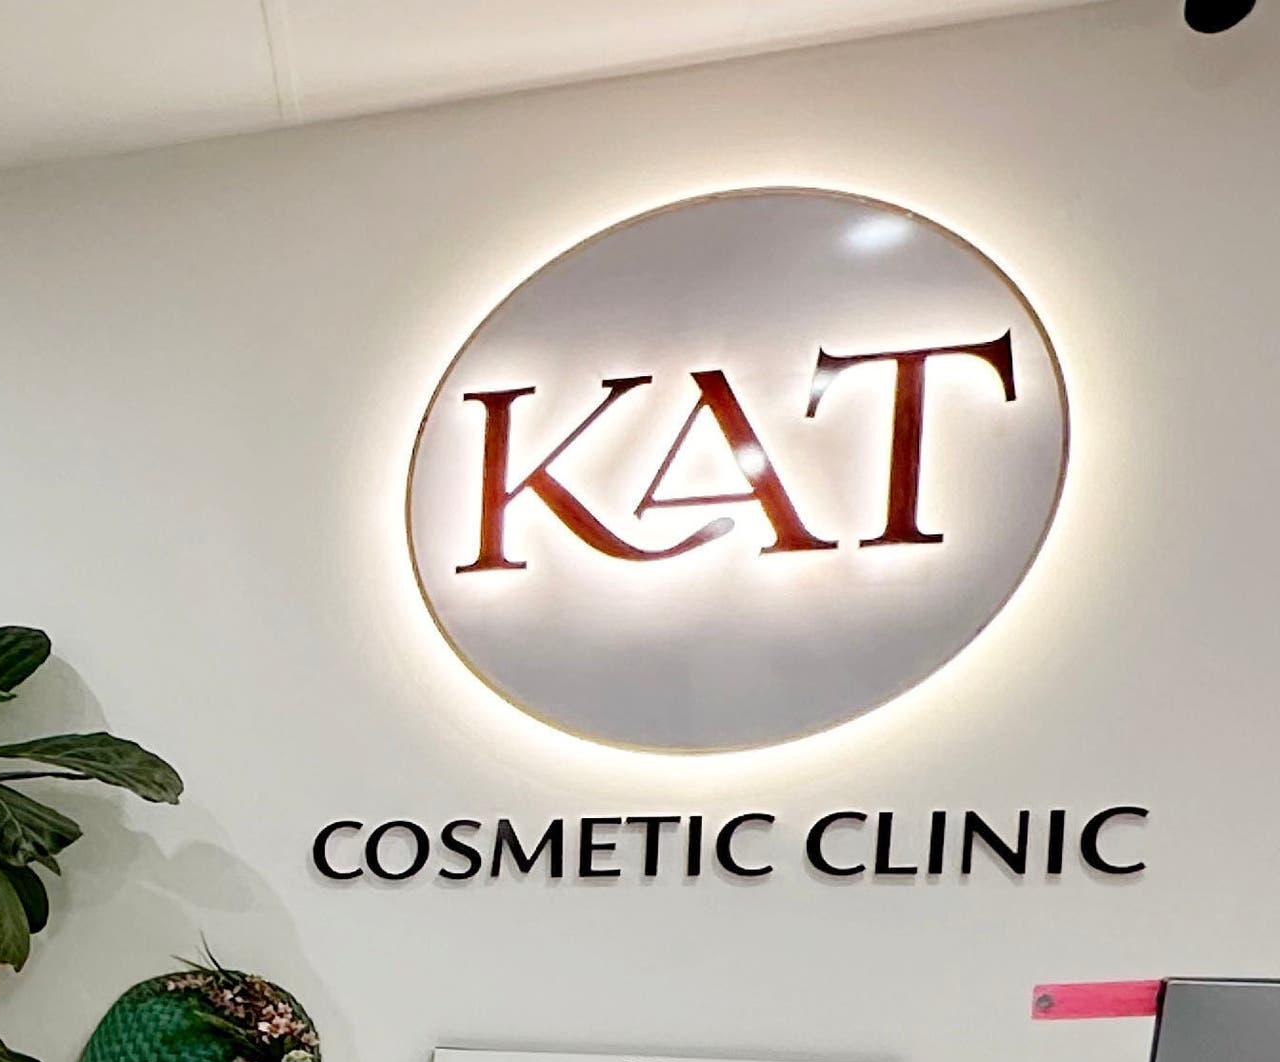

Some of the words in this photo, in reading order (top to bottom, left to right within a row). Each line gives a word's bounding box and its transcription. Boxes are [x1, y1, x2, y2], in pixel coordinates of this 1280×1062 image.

[454, 329, 1019, 575] KAT
[312, 812, 776, 882] COSMETIC
[805, 805, 1150, 876] CLINIC
